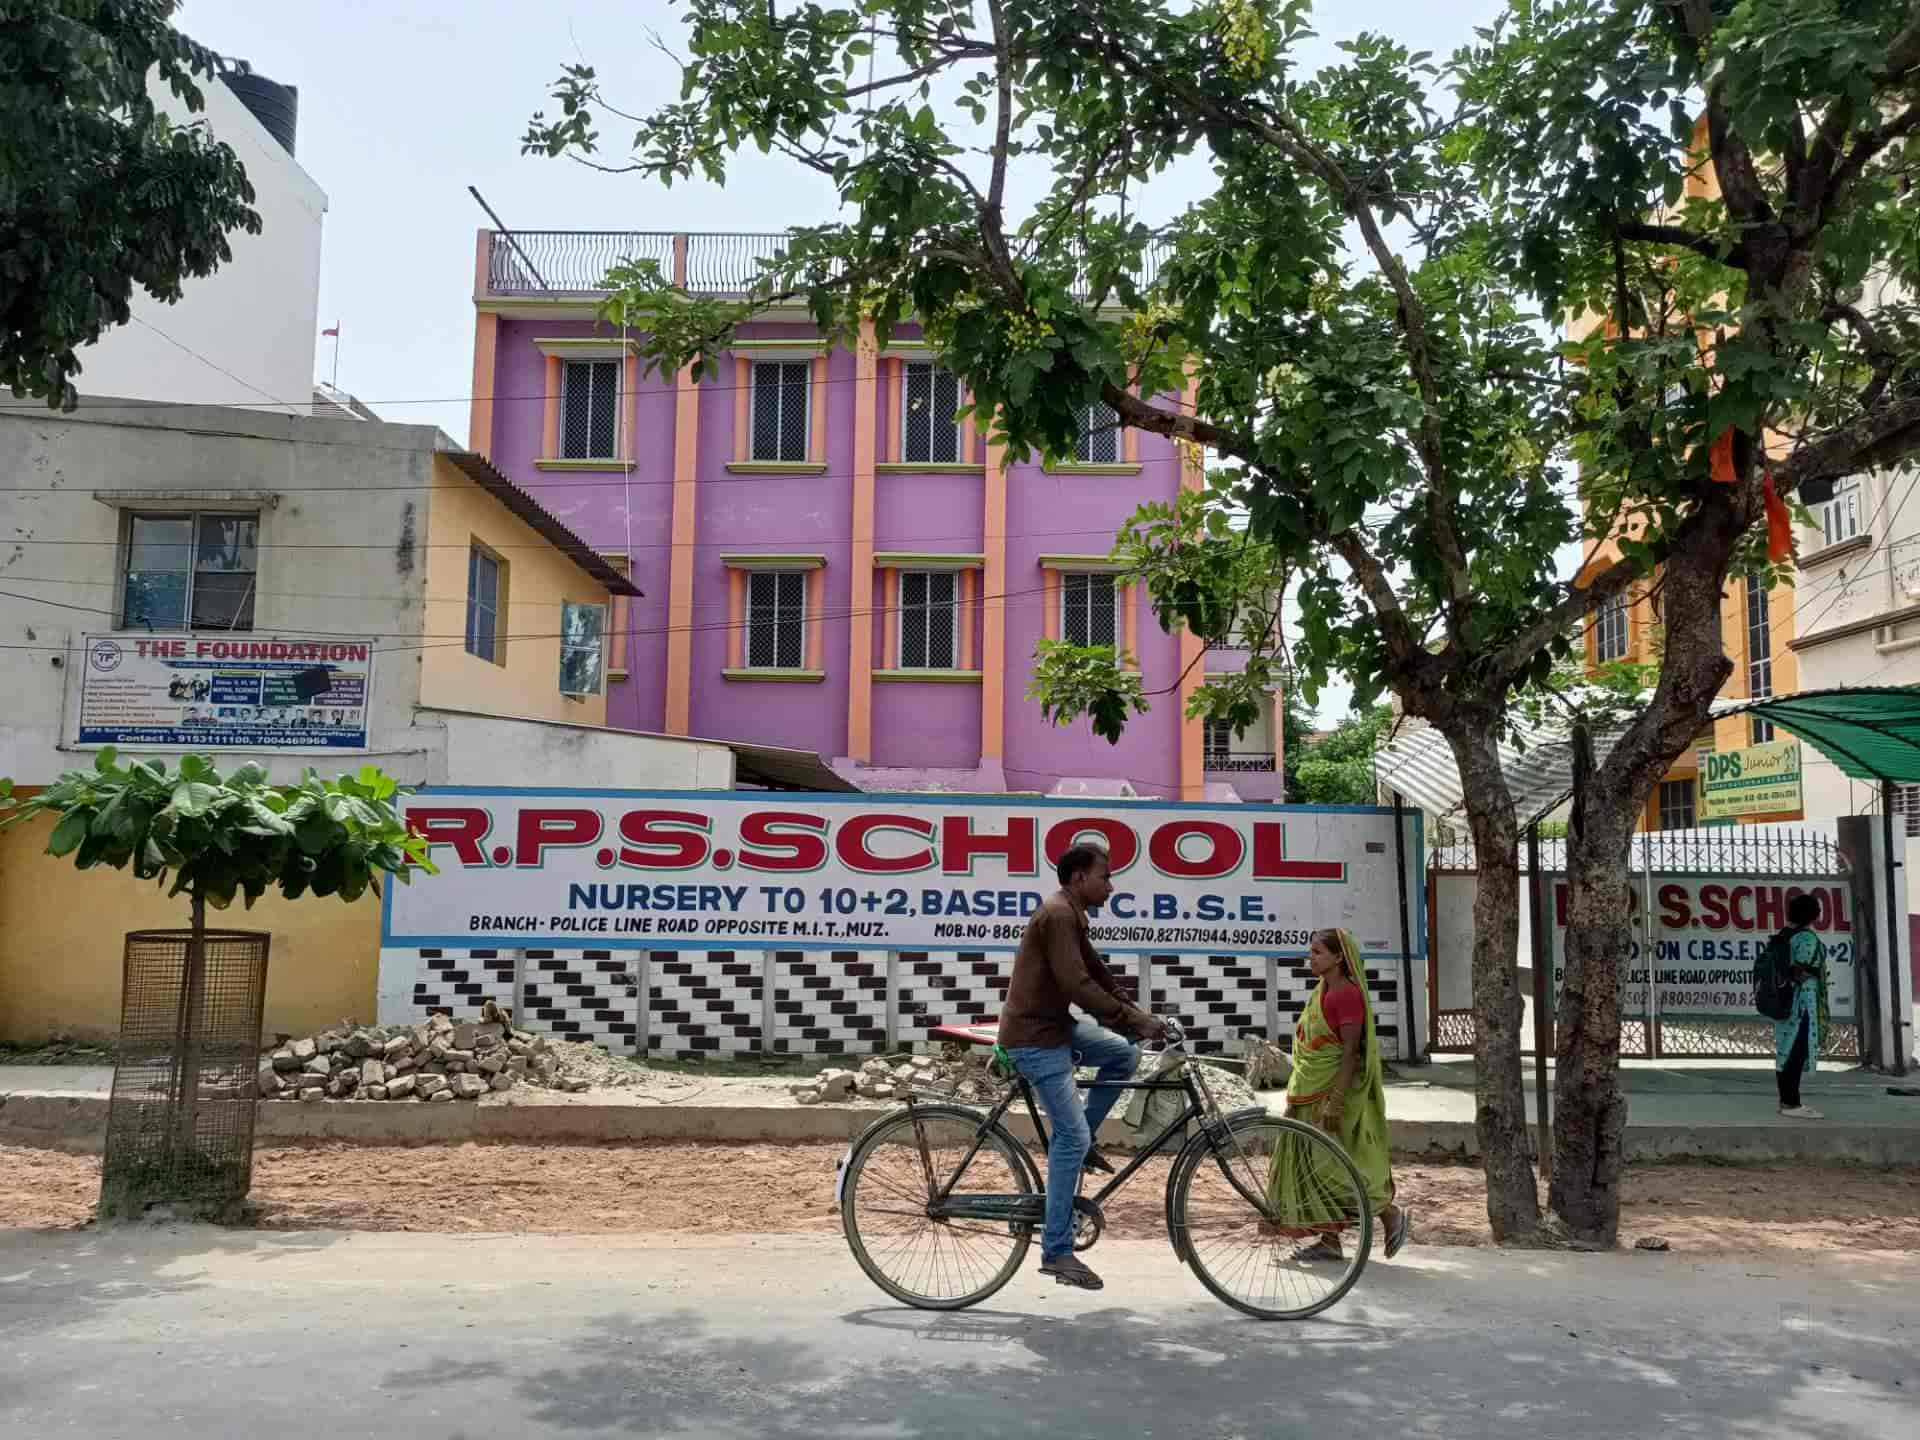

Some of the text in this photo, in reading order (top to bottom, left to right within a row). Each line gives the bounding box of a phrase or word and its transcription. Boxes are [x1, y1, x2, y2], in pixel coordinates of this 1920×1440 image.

[135, 641, 368, 662] THE FOUNDATION
[118, 734, 165, 742] Contact
[1708, 752, 1742, 781] DPS
[568, 883, 748, 912] NURSERY
[760, 886, 806, 914] TO
[1110, 893, 1277, 922] C.B.S.E.
[551, 917, 608, 932] POLICE
[614, 918, 651, 933] LINE
[657, 919, 699, 934] ROAD
[704, 920, 788, 936] OPPOSITE
[1655, 940, 1680, 960] ON
